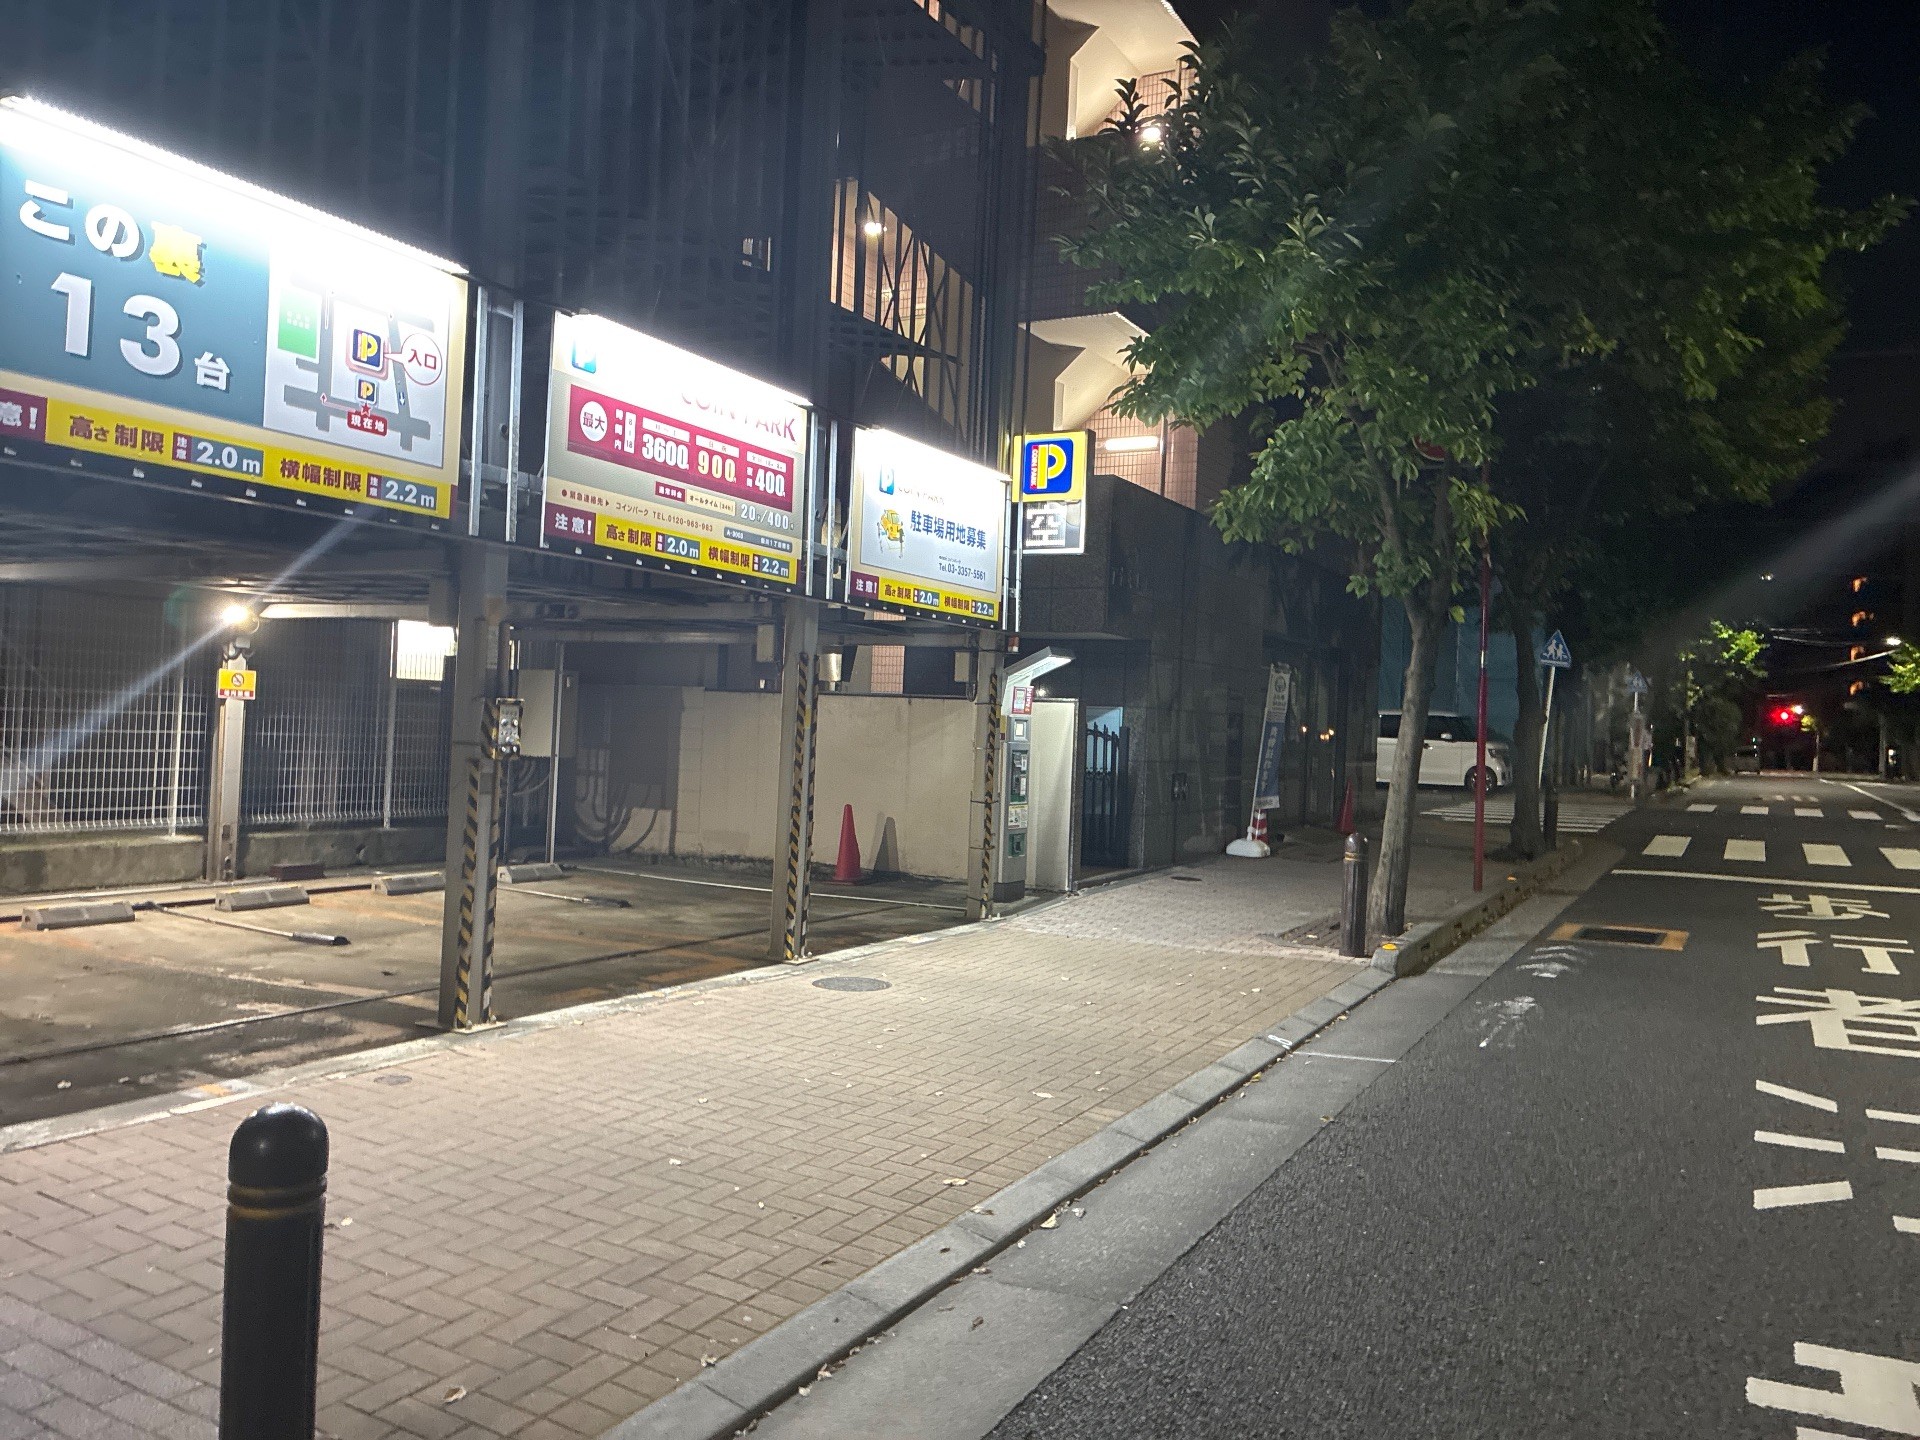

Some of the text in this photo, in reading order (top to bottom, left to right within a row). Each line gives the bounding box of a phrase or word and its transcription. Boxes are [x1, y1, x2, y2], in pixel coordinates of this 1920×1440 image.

[408, 349, 437, 370] 入口
[351, 414, 385, 432] 現在地
[583, 412, 605, 432] 最大
[69, 415, 164, 454] 高さ制限
[280, 457, 361, 493] 横幅制限
[616, 502, 649, 516] コインパーク
[910, 510, 986, 550] 駐車場用地募集
[1025, 500, 1066, 547] 空
[607, 523, 652, 547] 高さ制限
[708, 546, 750, 568] 横幅制限
[884, 584, 911, 600] 高さ制限
